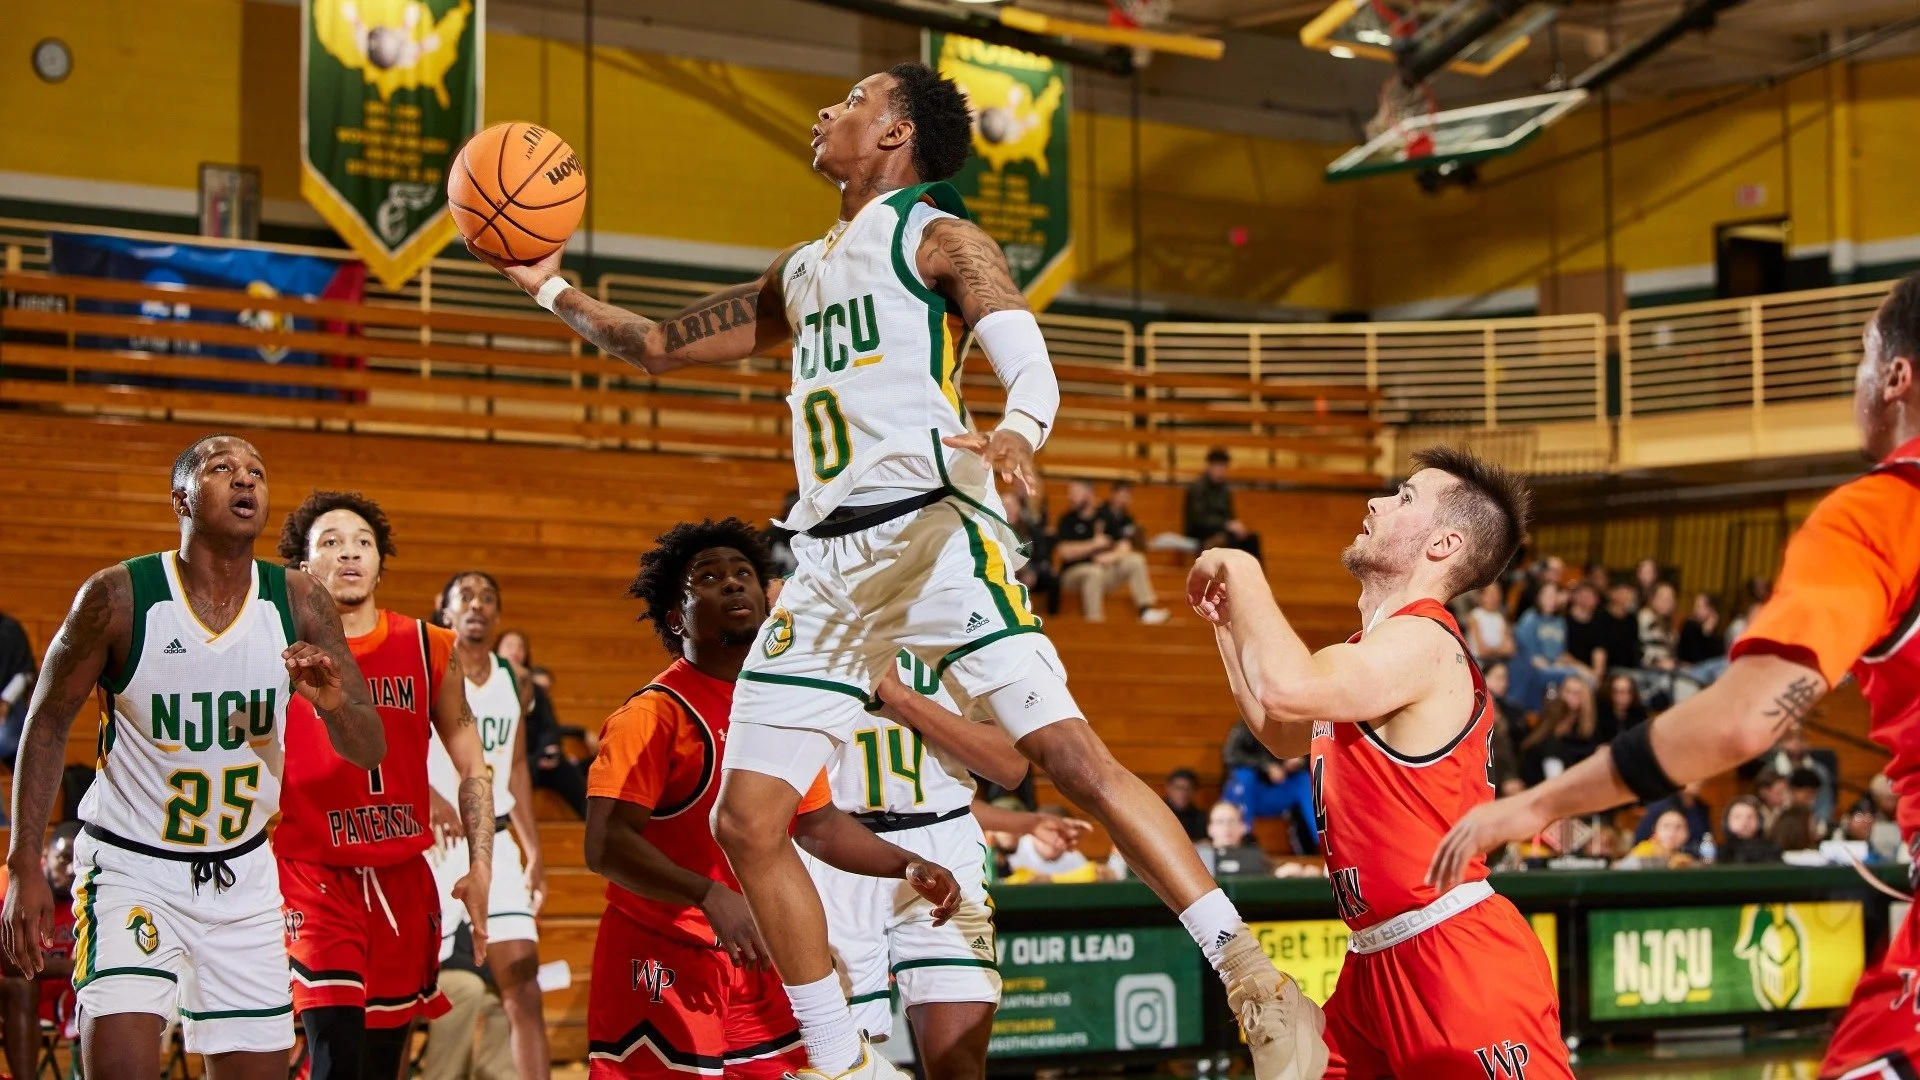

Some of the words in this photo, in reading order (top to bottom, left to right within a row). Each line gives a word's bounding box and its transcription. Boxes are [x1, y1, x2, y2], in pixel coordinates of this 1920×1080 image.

[795, 294, 881, 380] JCU
[803, 387, 853, 483] 0
[164, 646, 187, 654] adidas
[965, 618, 990, 634] adidas
[152, 688, 276, 752] NJCU
[854, 726, 926, 810] 14
[161, 763, 261, 847] 25
[631, 959, 676, 1003] WP
[1011, 936, 1066, 966] OUR
[1070, 933, 1136, 963] LEAD
[1613, 927, 1713, 1005] NJCU
[1474, 1040, 1529, 1080] WP
